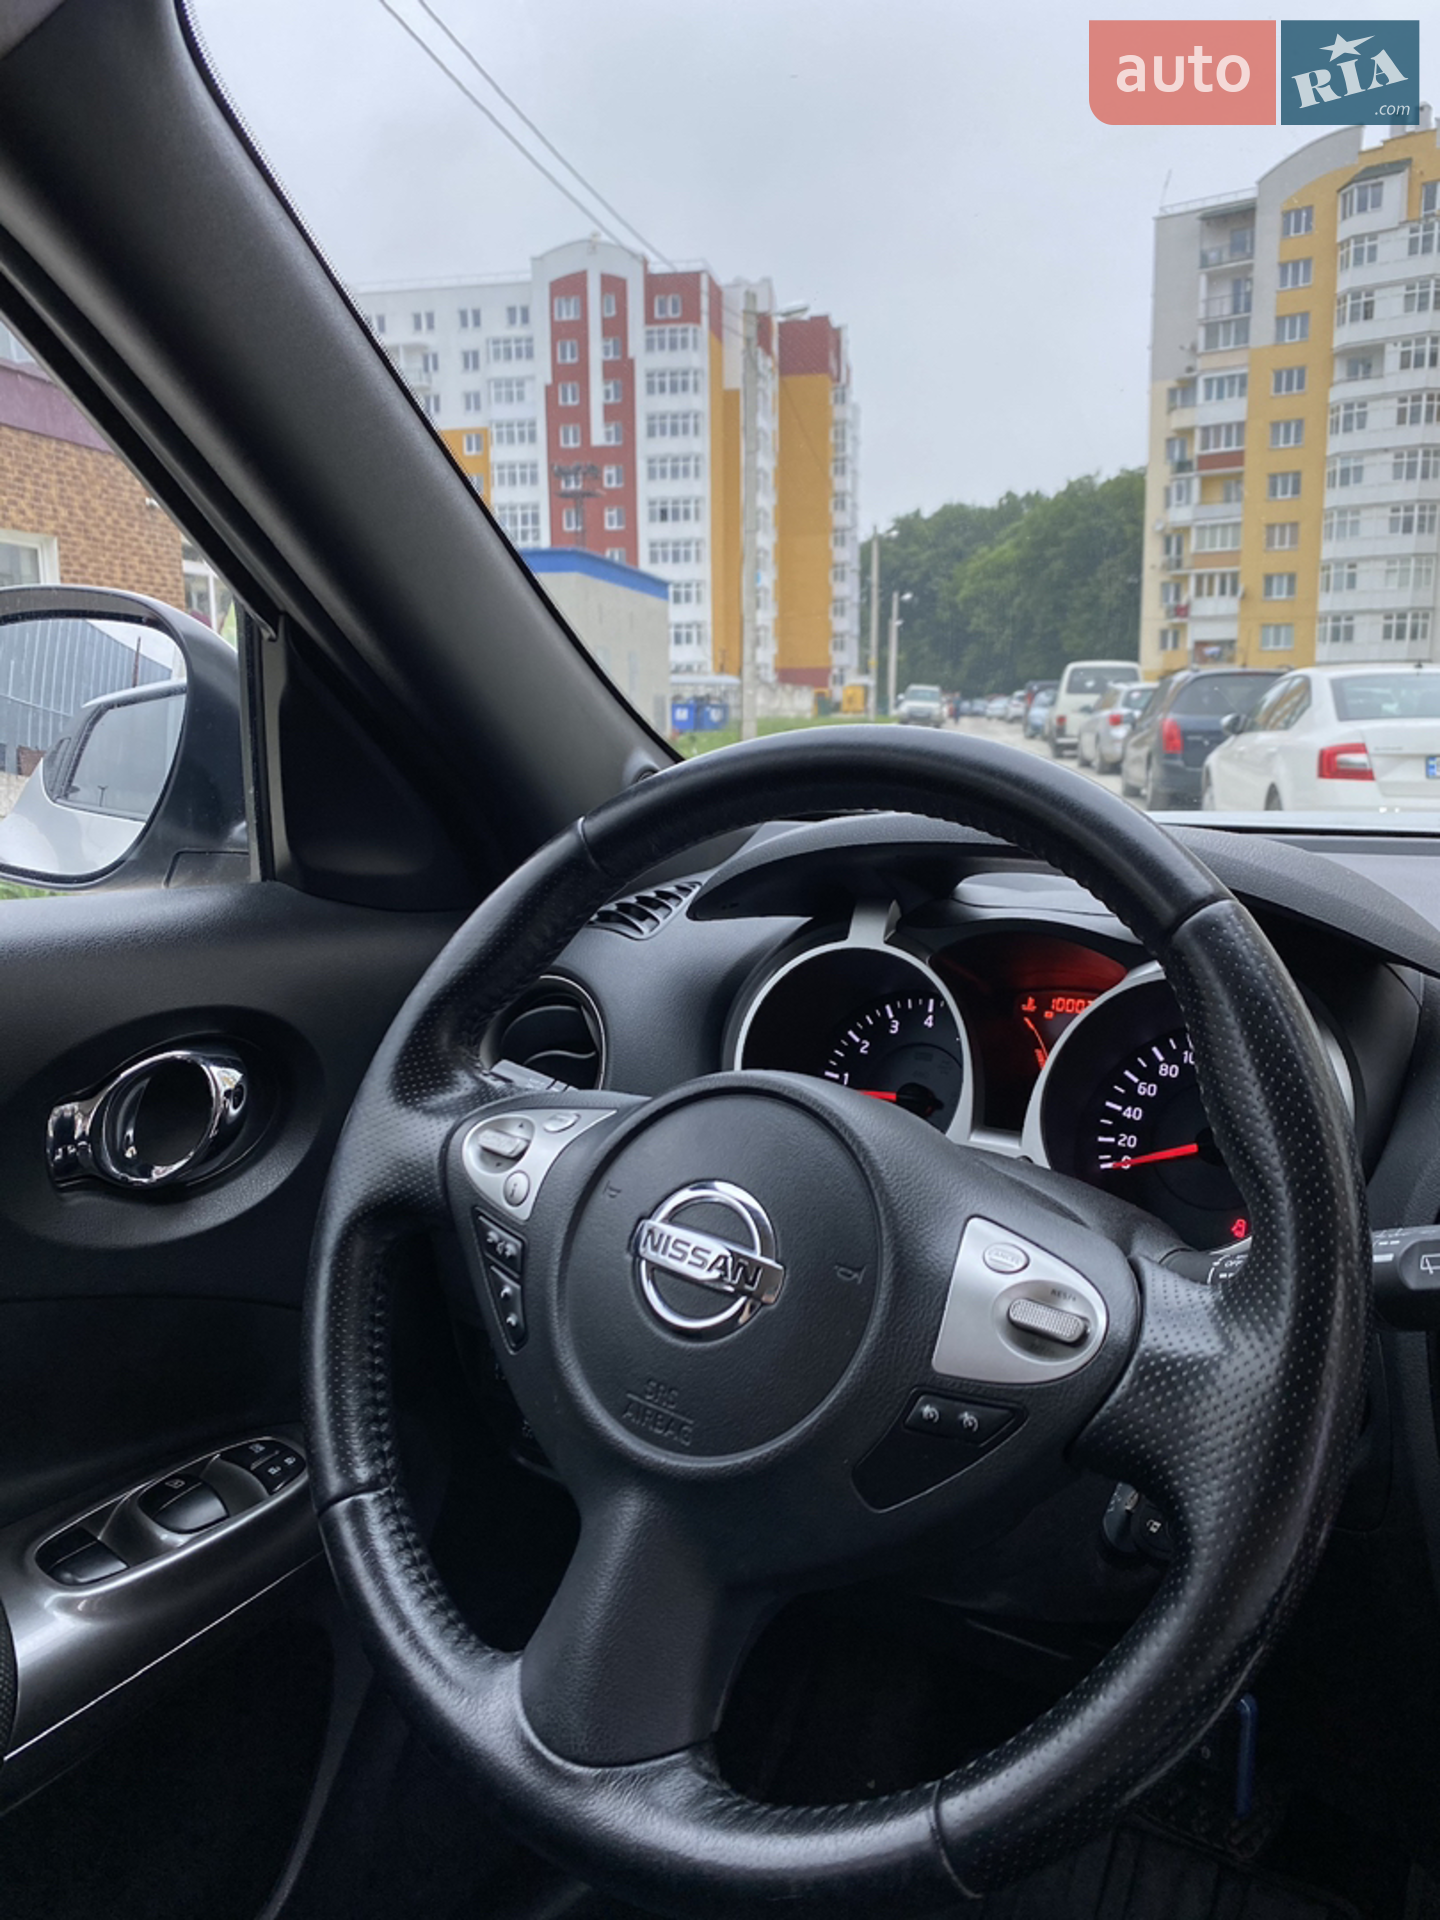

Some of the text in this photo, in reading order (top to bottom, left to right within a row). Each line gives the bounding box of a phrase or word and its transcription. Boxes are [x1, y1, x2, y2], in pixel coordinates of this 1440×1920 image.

[889, 1020, 900, 1034] 3
[924, 1015, 934, 1028] 4
[860, 1040, 870, 1054] 2
[1158, 1063, 1180, 1078] 80
[1137, 1082, 1158, 1097] 60
[1122, 1106, 1142, 1121] 40
[1117, 1133, 1138, 1148] 20
[642, 1229, 762, 1291] NISSAN
